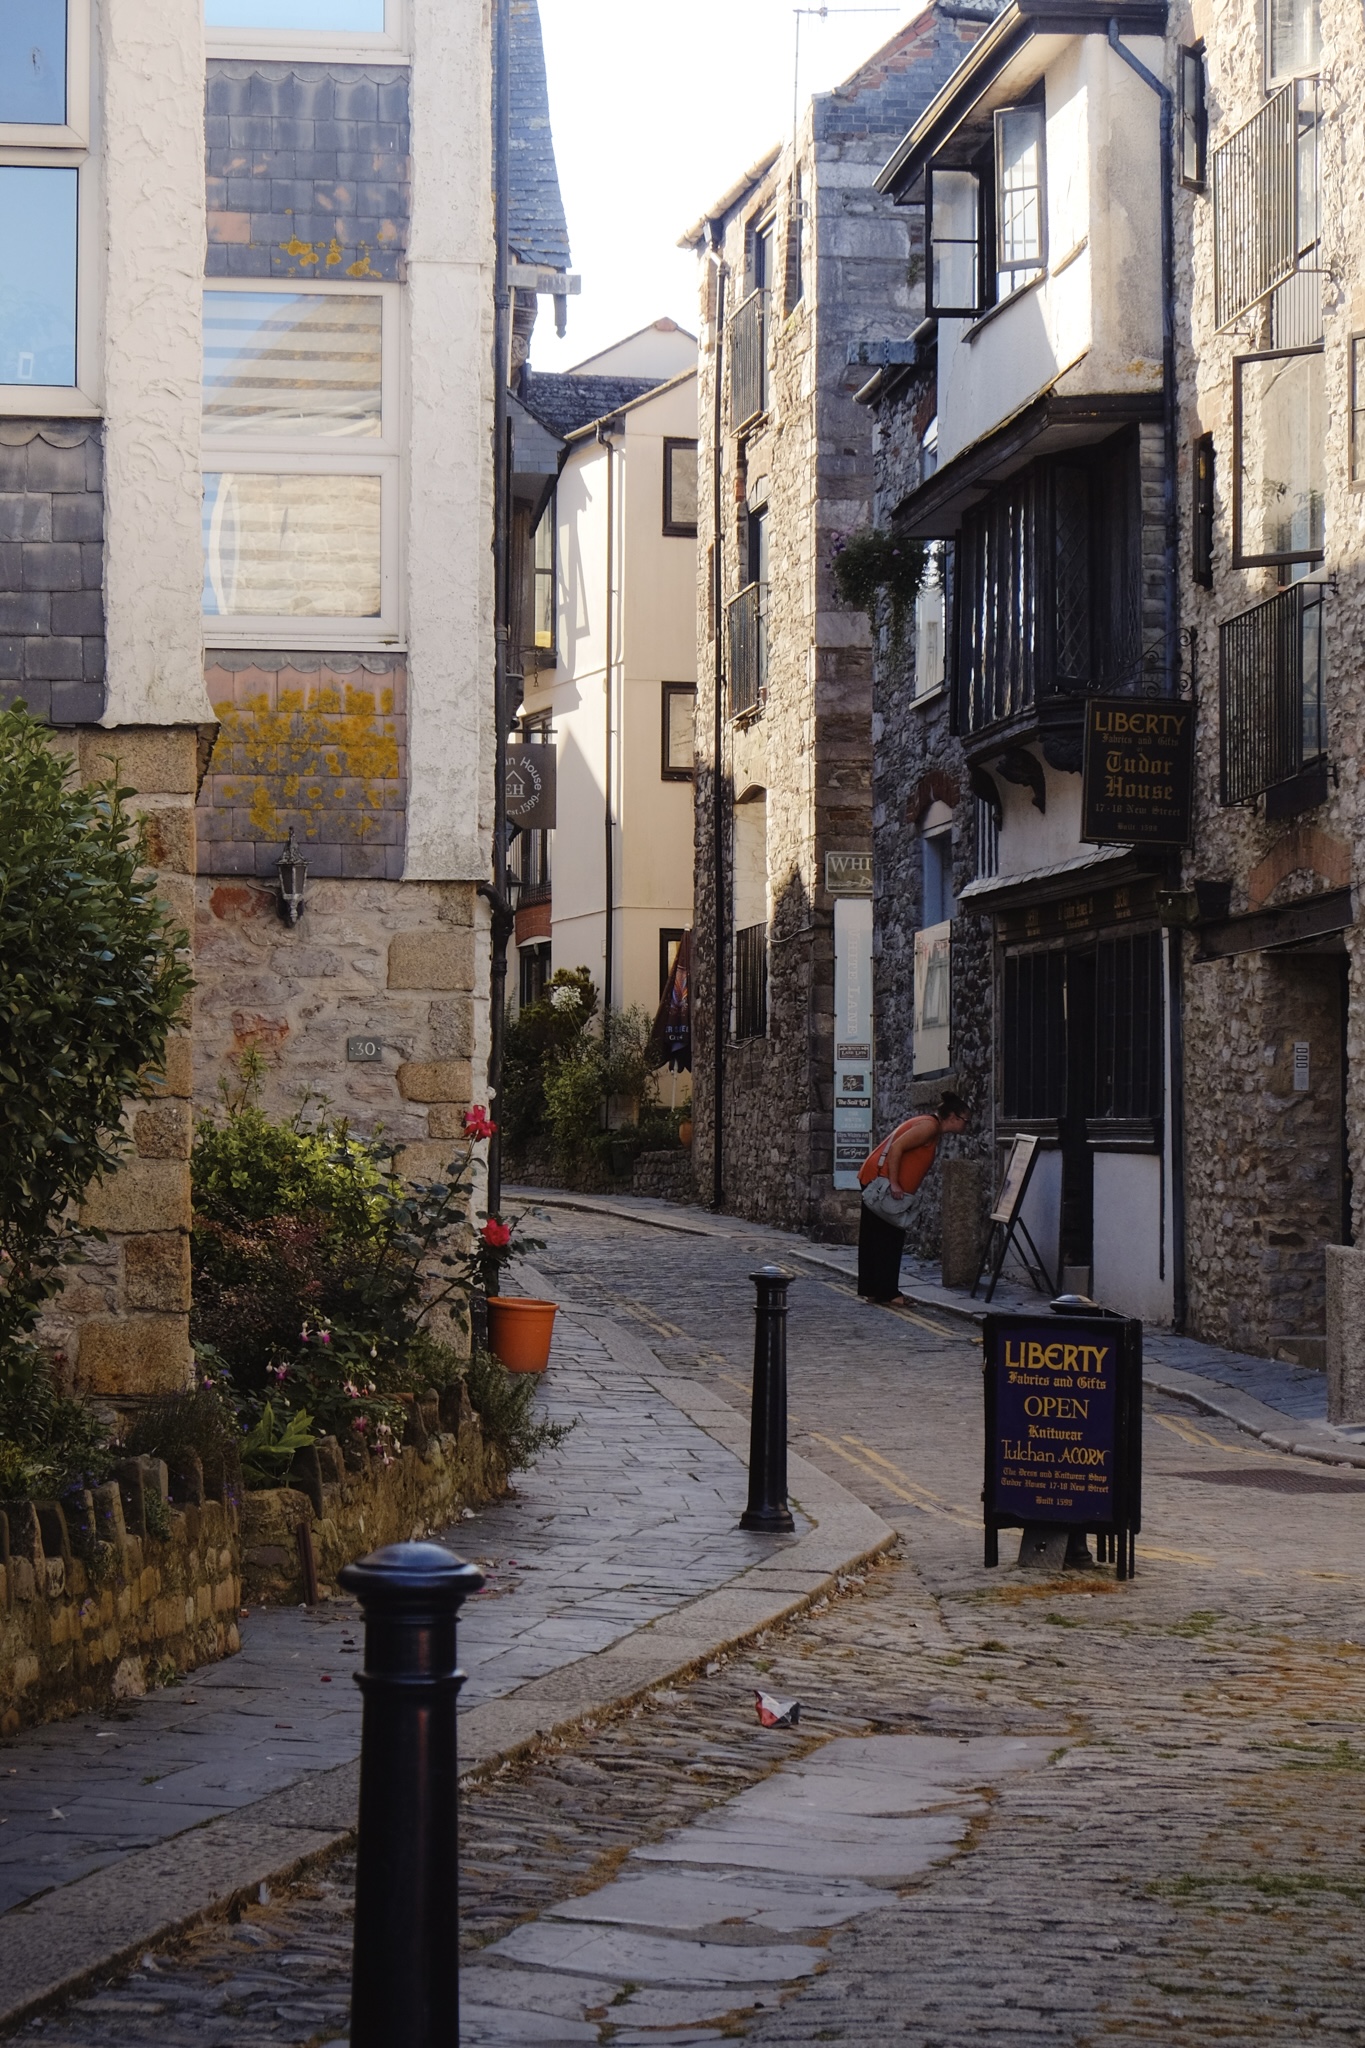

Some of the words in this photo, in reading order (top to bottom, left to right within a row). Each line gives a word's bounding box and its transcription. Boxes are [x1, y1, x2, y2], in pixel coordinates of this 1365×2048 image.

[1095, 711, 1186, 735] LIBERTY
[1102, 733, 1132, 744] Fabrics
[1138, 736, 1152, 745] and
[1158, 736, 1179, 747] Gifts
[1105, 750, 1174, 776] Tudor
[520, 756, 543, 791] House
[505, 784, 525, 796] EH
[1103, 775, 1174, 800] House
[1126, 804, 1147, 814] New
[1151, 805, 1181, 816] Street
[829, 857, 874, 873] WHI
[355, 1041, 376, 1056] 30
[1005, 1340, 1109, 1373] LIBERTY
[1007, 1371, 1050, 1386] Fabrics
[1053, 1376, 1073, 1388] and
[1077, 1376, 1107, 1390] Gifts
[1024, 1395, 1090, 1419] OPEN
[1028, 1424, 1083, 1441] Knitwear
[1001, 1439, 1055, 1463] Tulchan
[1058, 1447, 1111, 1466] ACORN
[1003, 1467, 1016, 1476] The
[1019, 1468, 1037, 1477] Dress
[1040, 1470, 1052, 1479] and
[1054, 1470, 1086, 1481] Knitwear
[1088, 1473, 1107, 1483] Shop
[1001, 1477, 1022, 1487] Tudor
[1024, 1479, 1046, 1489] House
[1049, 1481, 1068, 1491] 17-18
[1070, 1482, 1085, 1492] New
[1087, 1484, 1109, 1493] Street
[1035, 1496, 1053, 1505] Built
[1056, 1498, 1073, 1506] 1599
